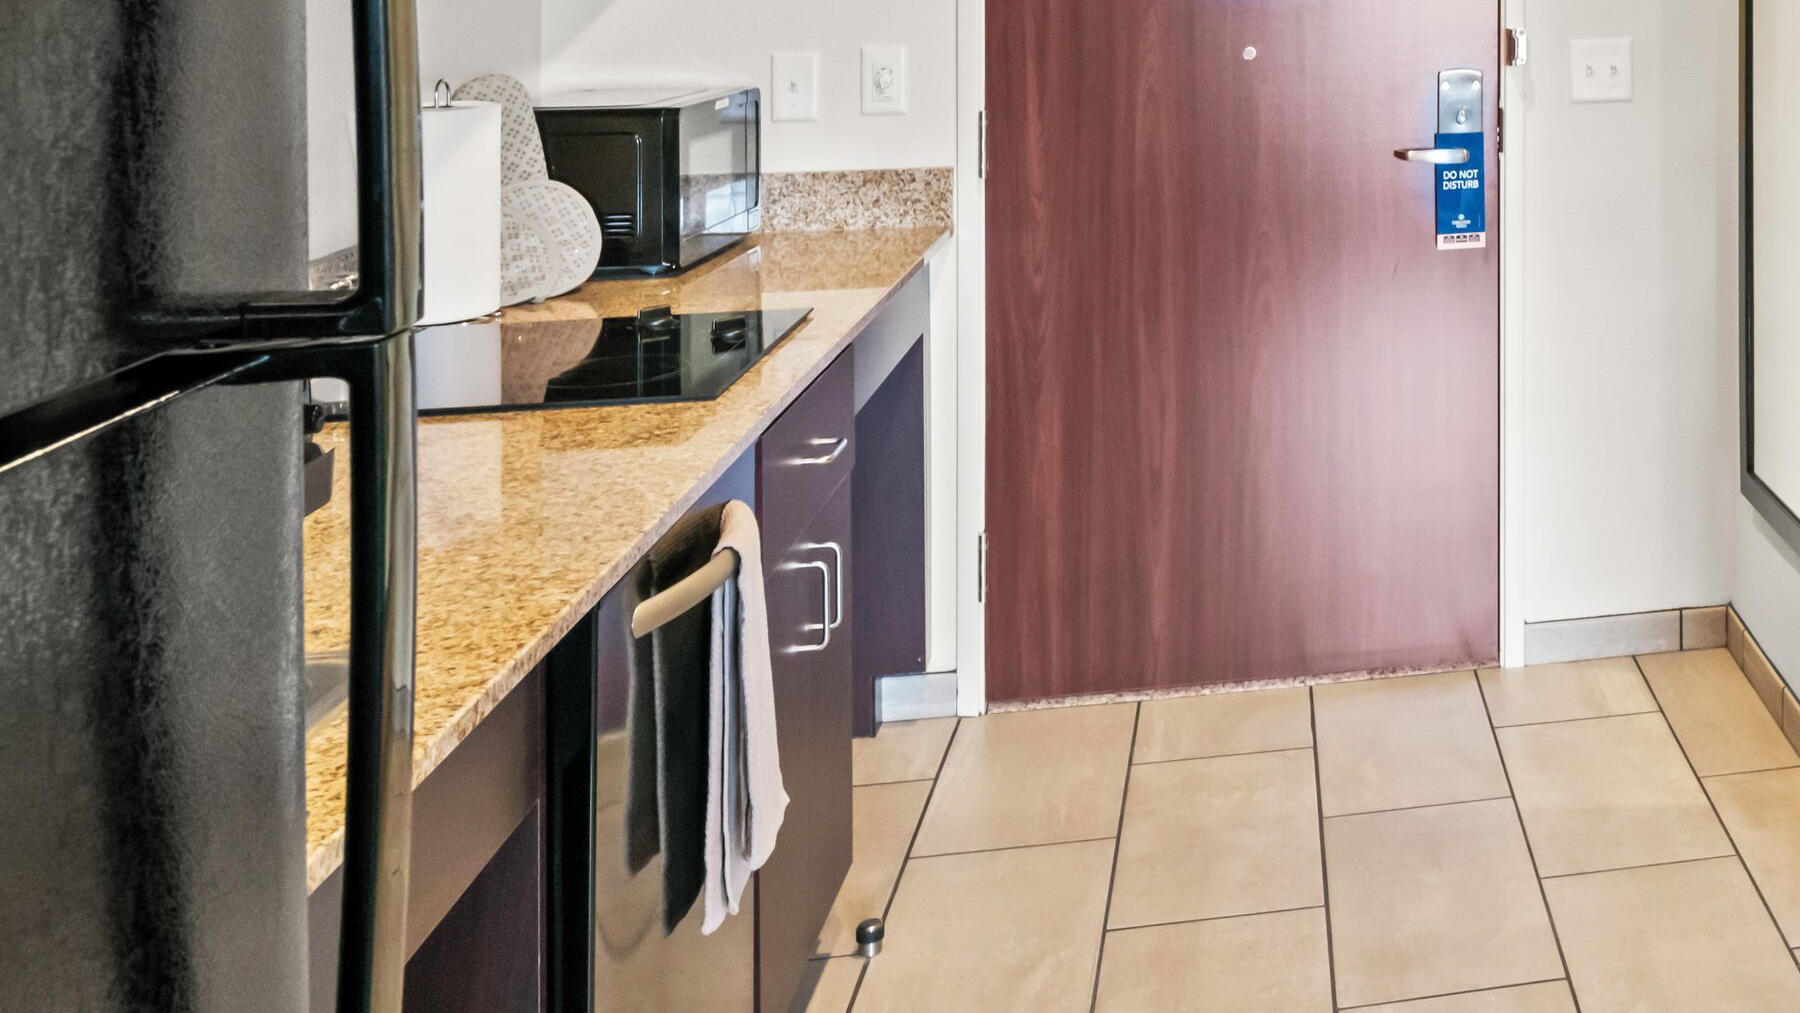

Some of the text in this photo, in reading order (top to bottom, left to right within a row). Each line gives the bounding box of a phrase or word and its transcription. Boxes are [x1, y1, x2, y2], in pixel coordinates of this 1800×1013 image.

[1443, 169, 1479, 180] DO NOT
[1443, 179, 1479, 190] DISTURB
